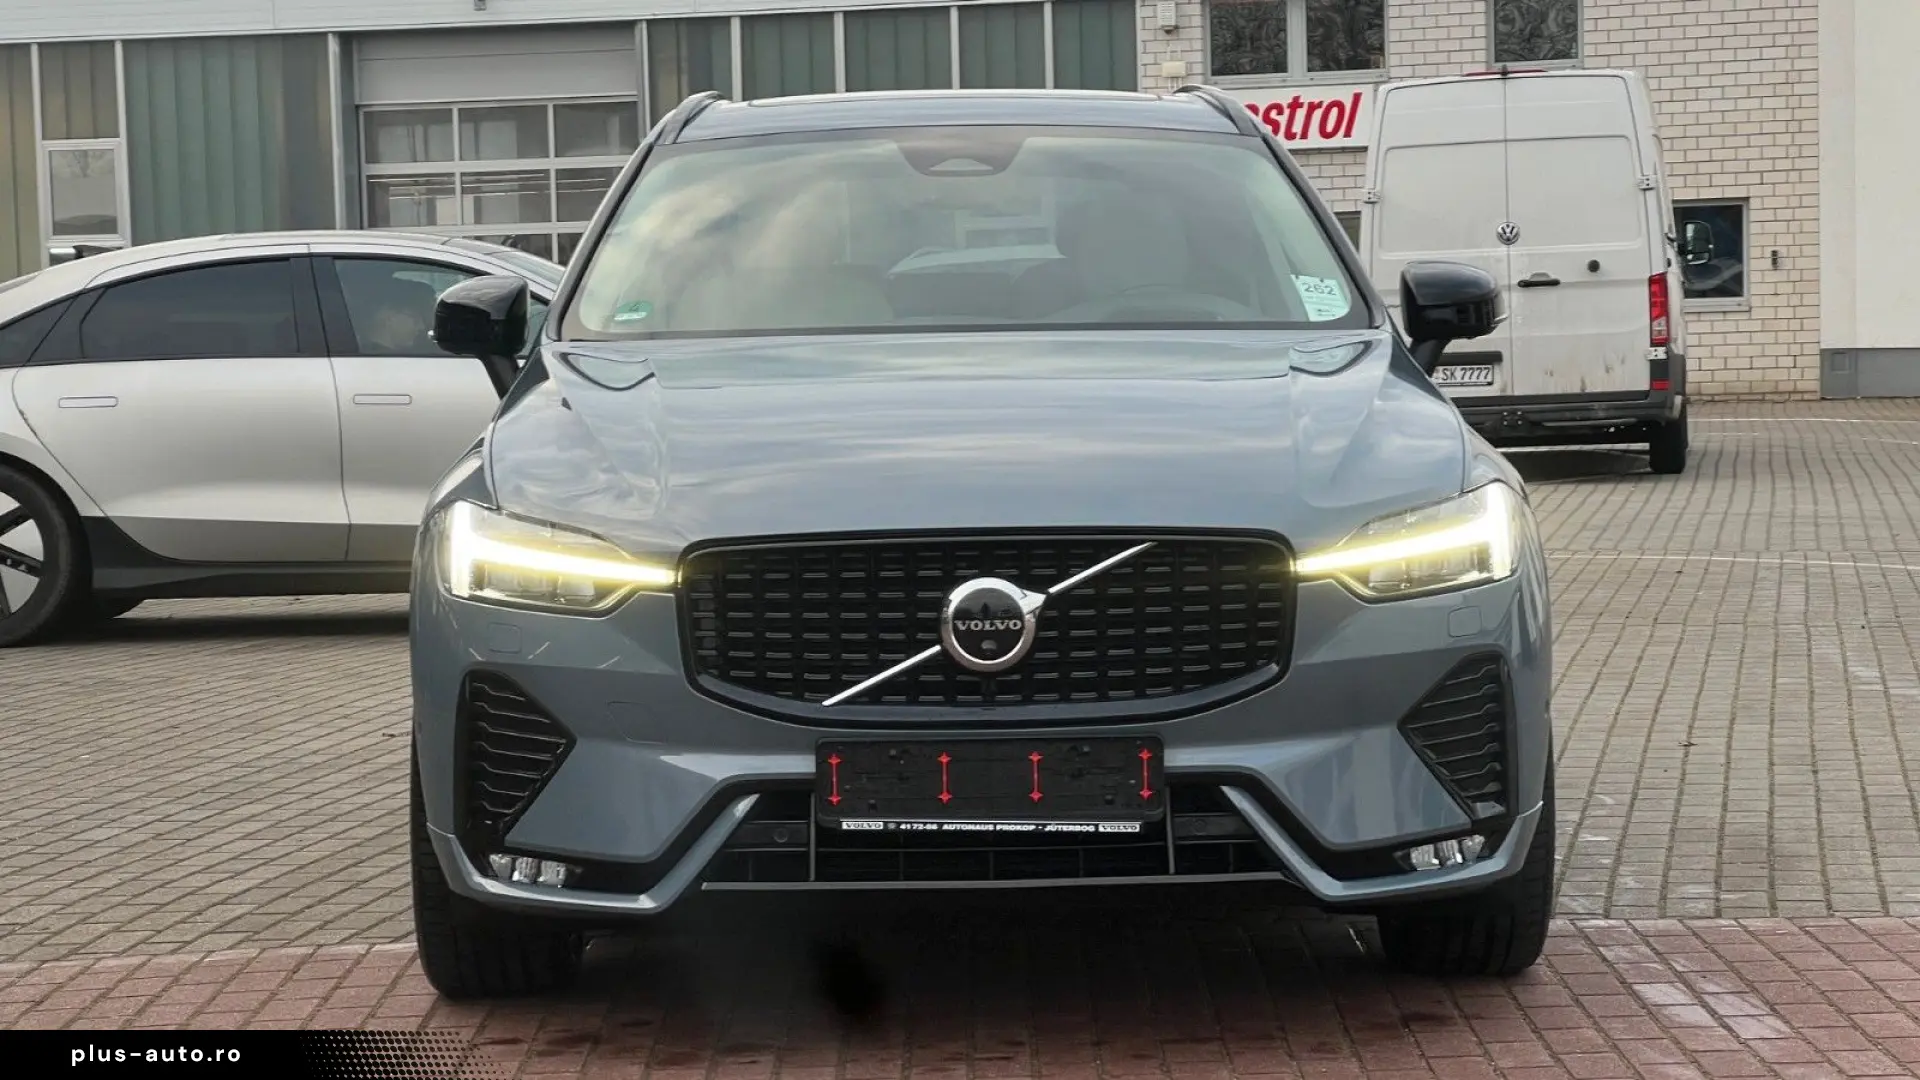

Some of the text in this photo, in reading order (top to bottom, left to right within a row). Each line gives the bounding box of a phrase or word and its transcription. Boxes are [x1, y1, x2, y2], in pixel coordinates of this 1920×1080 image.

[1302, 282, 1337, 296] 262
[1442, 366, 1491, 381] SK 7777
[954, 619, 1022, 631] VOLVO
[942, 823, 994, 831] AUTOHAUS
[1044, 822, 1096, 832] JÜTERBOG
